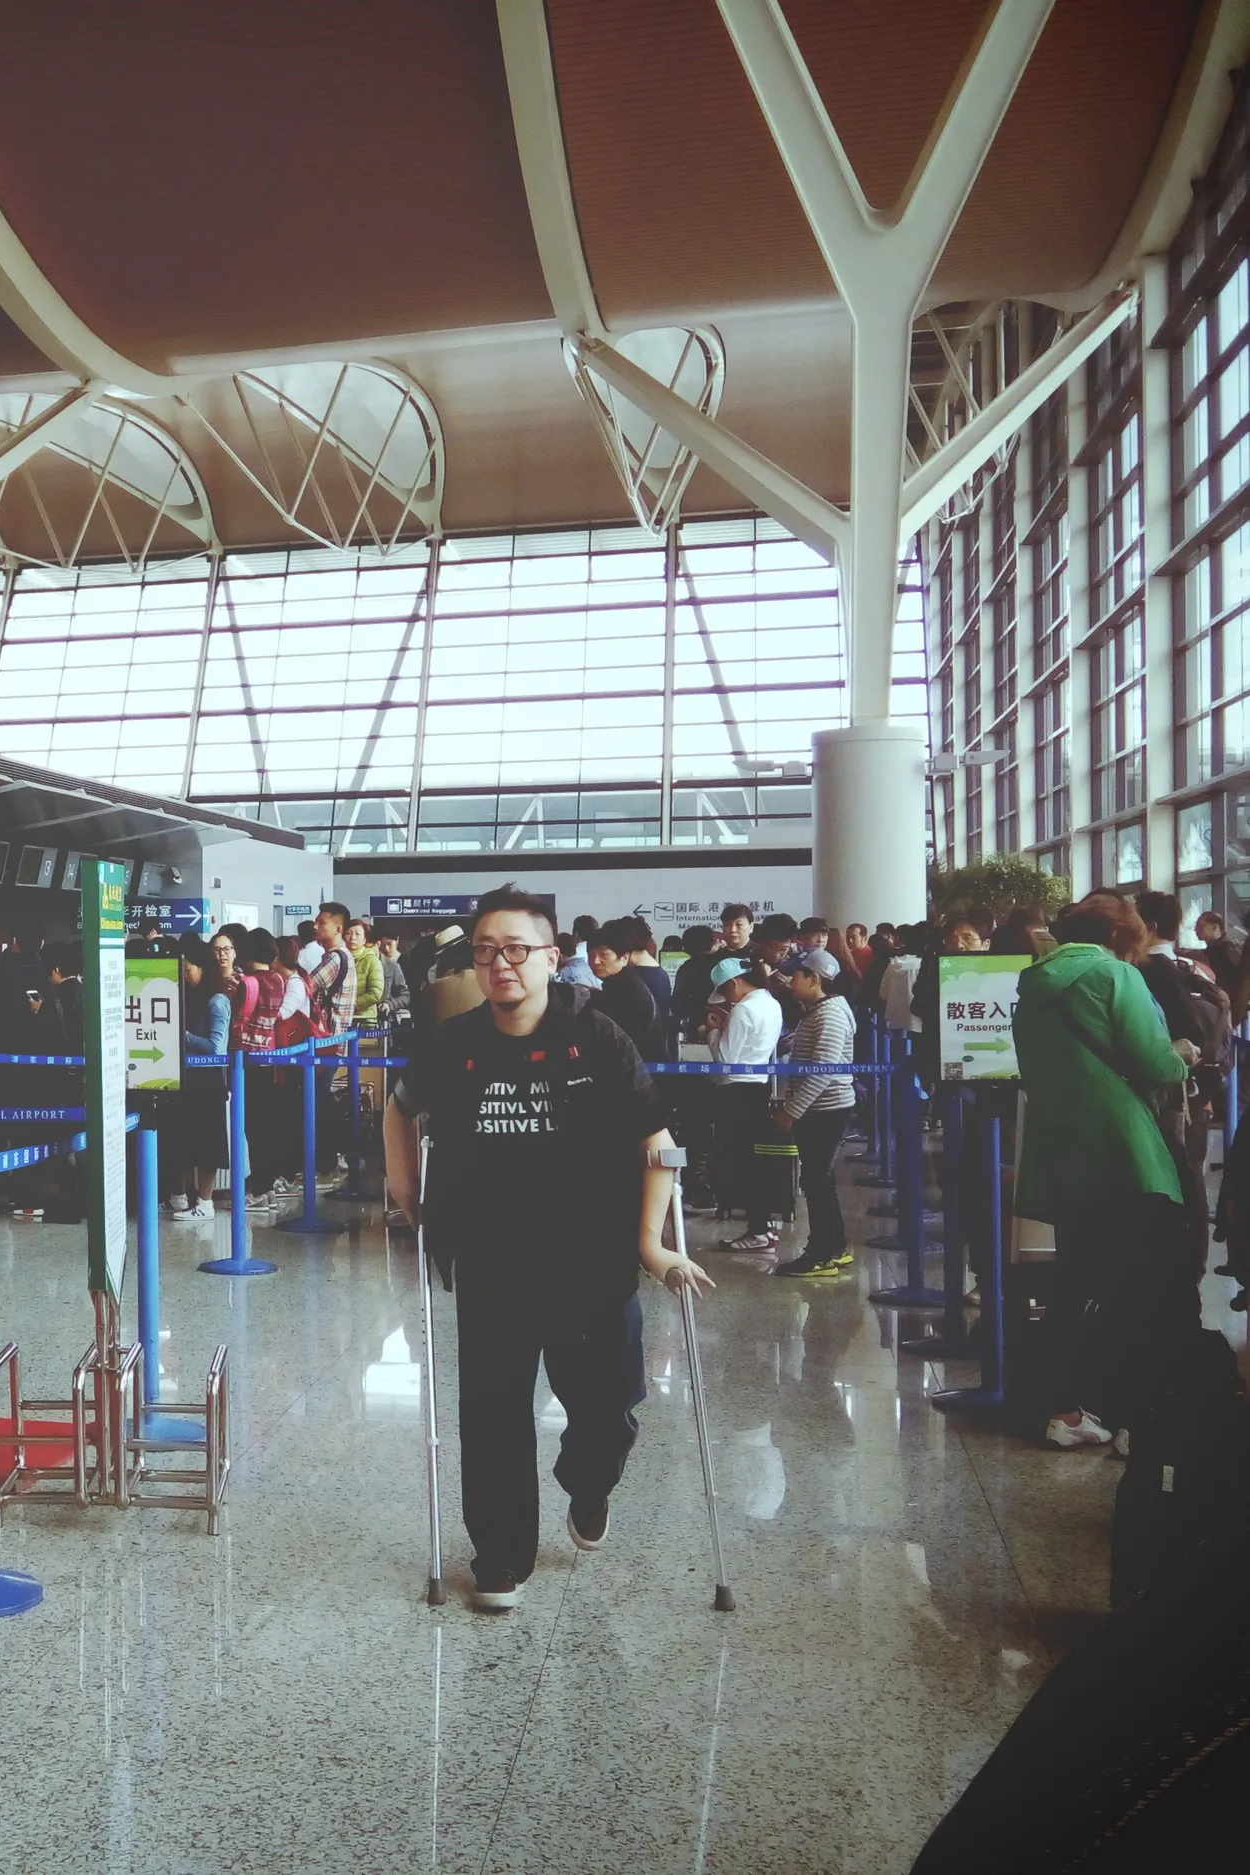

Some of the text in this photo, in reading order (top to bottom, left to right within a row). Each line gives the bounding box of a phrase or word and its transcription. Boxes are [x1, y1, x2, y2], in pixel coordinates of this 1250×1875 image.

[125, 995, 170, 1024] 出口
[957, 1023, 1012, 1033] Passenger
[136, 1029, 157, 1041] Exit
[847, 1064, 896, 1073] INTERNA
[12, 1110, 66, 1119] AIRPORT
